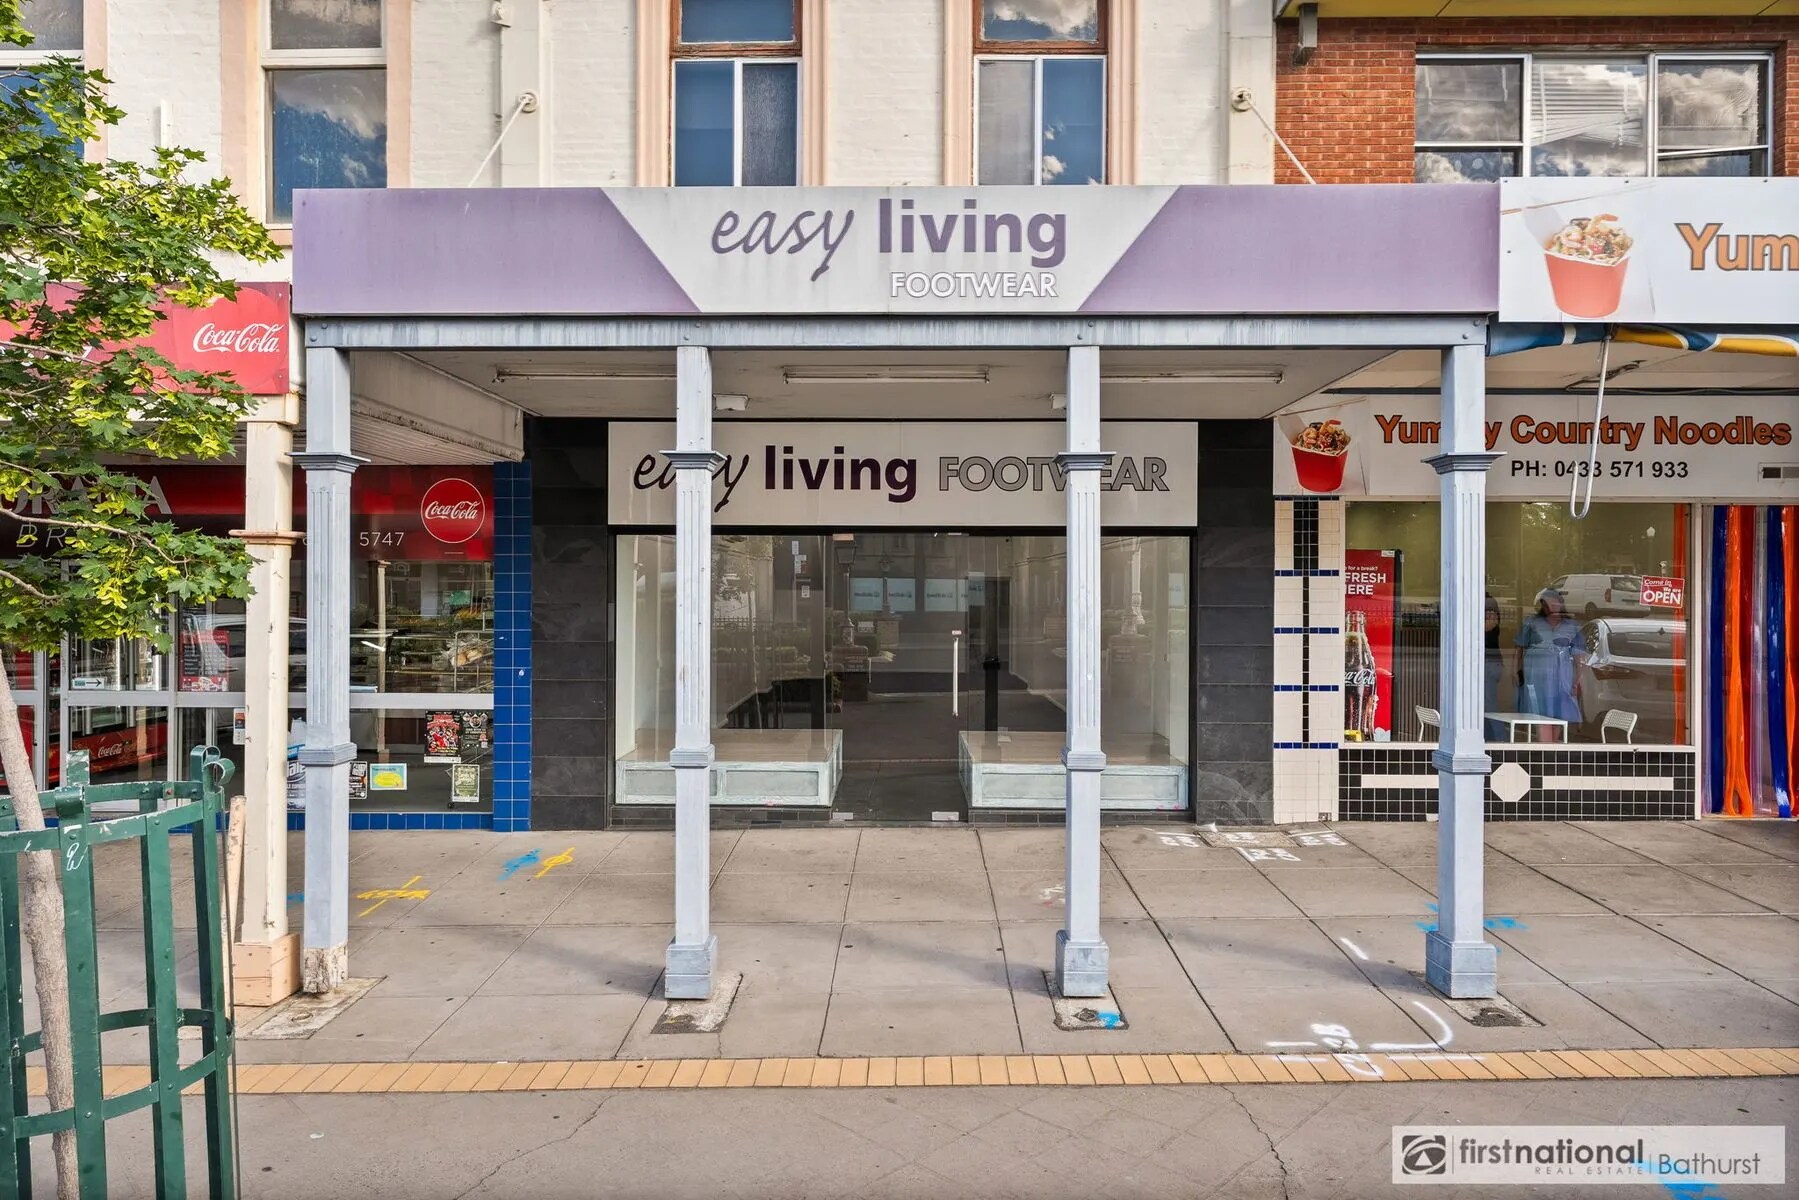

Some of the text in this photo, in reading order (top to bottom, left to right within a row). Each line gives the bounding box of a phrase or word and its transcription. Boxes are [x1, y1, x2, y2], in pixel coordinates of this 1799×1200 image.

[711, 198, 1067, 282] easy living
[890, 271, 1059, 298] FOOTWEAR
[193, 322, 285, 353] Coca-Cola
[1374, 414, 1793, 452] Yumy Country Noodles
[765, 445, 917, 504] living
[1511, 460, 1689, 478] PH: 0433 571 933
[425, 500, 481, 520] Coca-Cola
[359, 531, 405, 547] 5747
[1345, 572, 1387, 583] FRESH
[1345, 584, 1374, 595] ERE
[1643, 590, 1682, 605] OPEN
